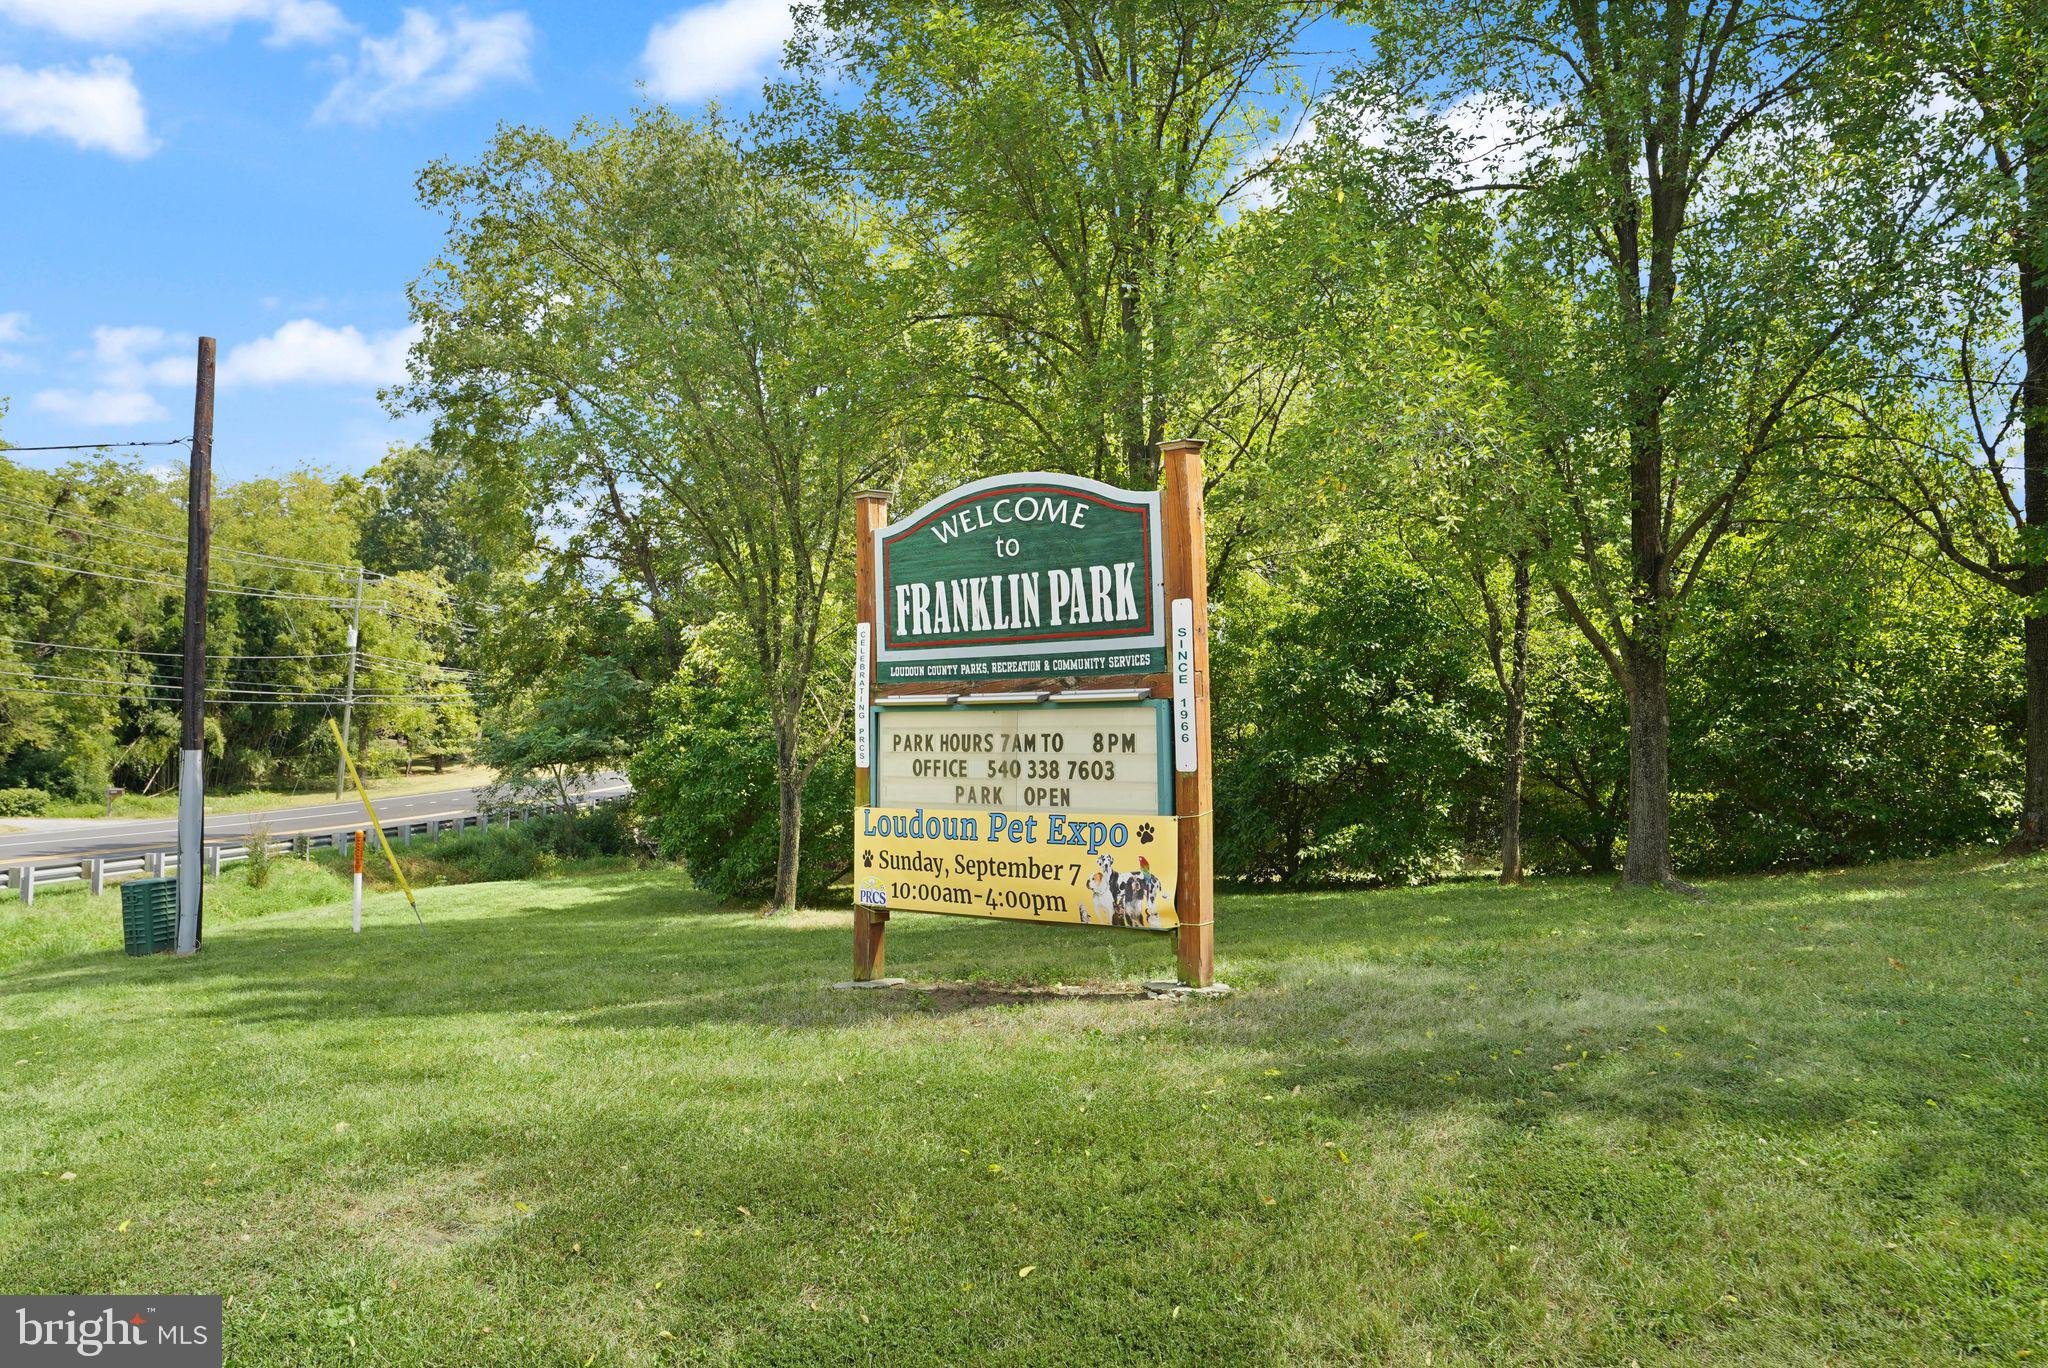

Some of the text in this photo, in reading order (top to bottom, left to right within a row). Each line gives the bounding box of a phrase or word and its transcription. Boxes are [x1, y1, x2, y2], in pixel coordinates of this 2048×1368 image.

[930, 496, 1090, 544] WELCOME
[995, 535, 1020, 558] to
[895, 562, 1139, 636] FRANKLIN PARK
[858, 631, 866, 719] CELEBRATING
[890, 654, 1151, 677] LOUDOUN COUNTY PARKS, RECREATION & COMMUNITY SERVICES
[1178, 627, 1190, 743] SINCE 1966
[893, 733, 934, 752] PARK
[940, 733, 994, 752] HOURS
[912, 759, 1115, 781] OFFICE 540 338 7603
[955, 786, 1071, 807] PARK OPEN
[863, 808, 1129, 855] Loudoun Pet Expo
[879, 849, 1082, 886] Sunday, September 7
[860, 890, 886, 904] PRCS
